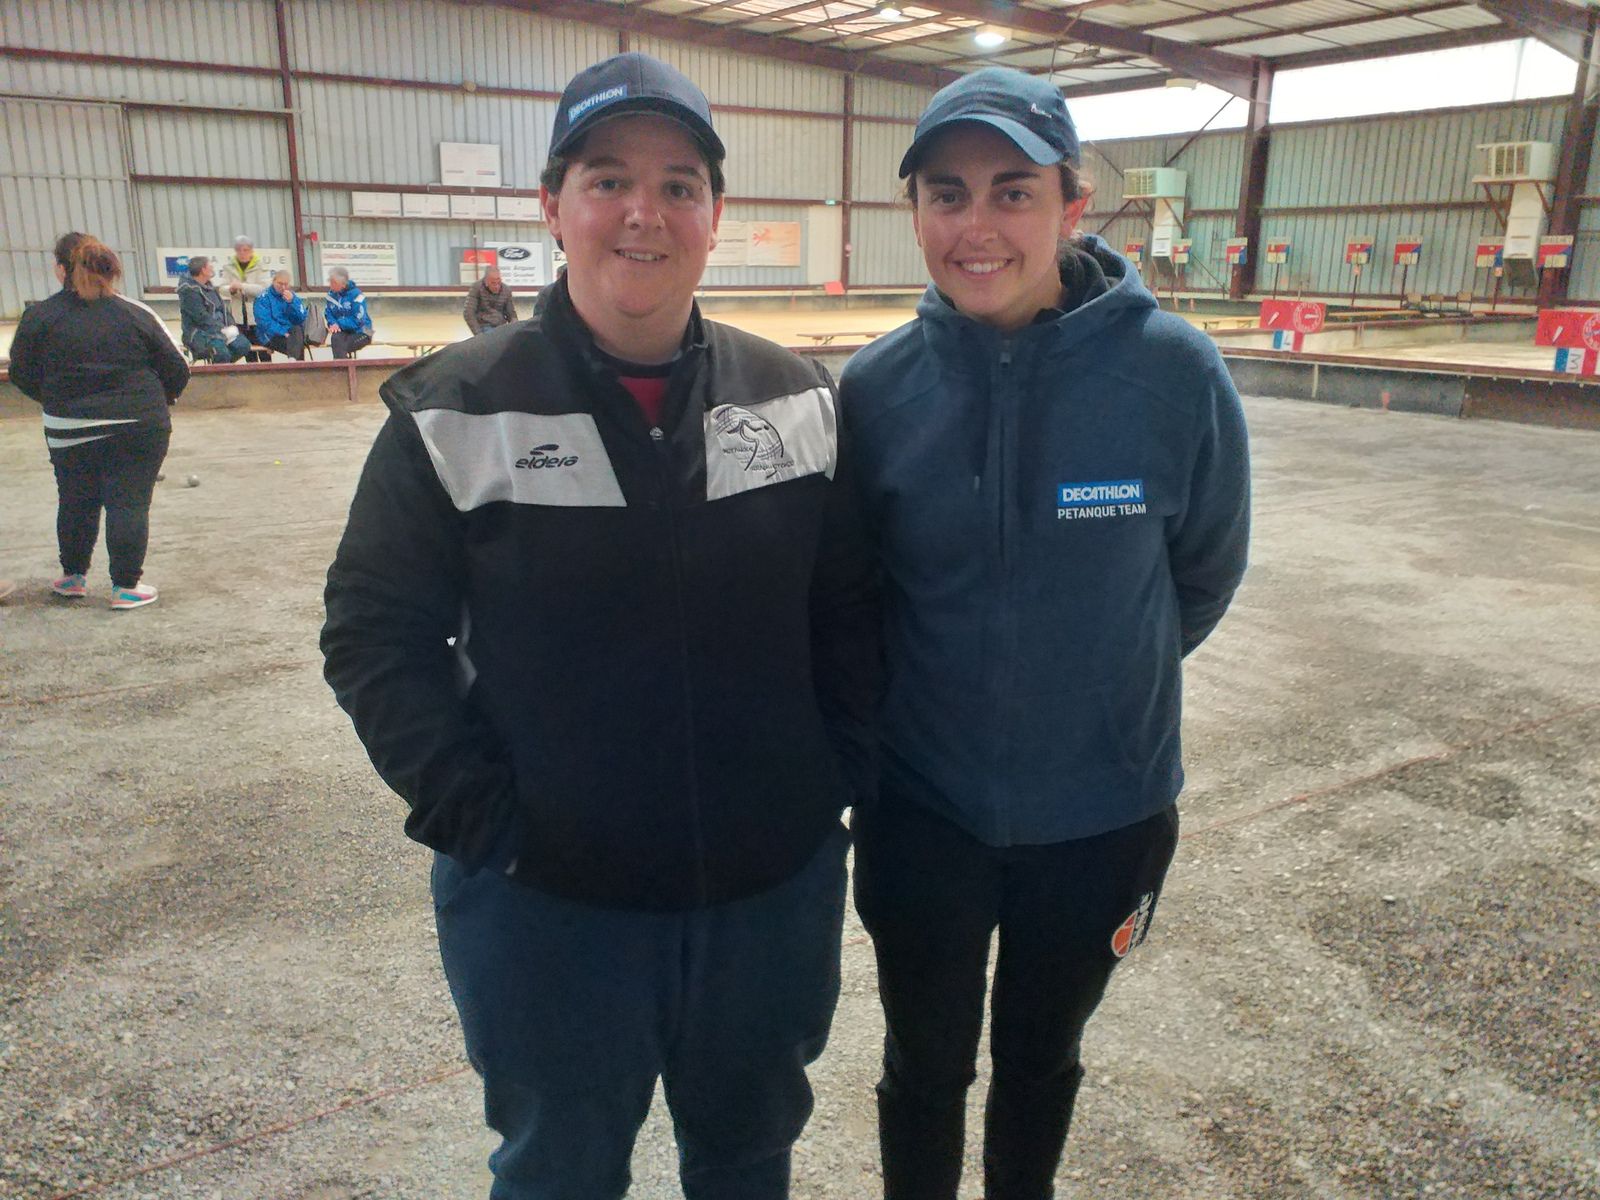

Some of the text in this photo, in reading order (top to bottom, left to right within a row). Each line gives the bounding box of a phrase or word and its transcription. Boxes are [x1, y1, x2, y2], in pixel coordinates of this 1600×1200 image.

[568, 85, 624, 125] DECATHLON
[514, 455, 579, 470] eldera
[1062, 483, 1140, 503] DECATHLON
[1057, 503, 1147, 520] PETANQUE TEAM
